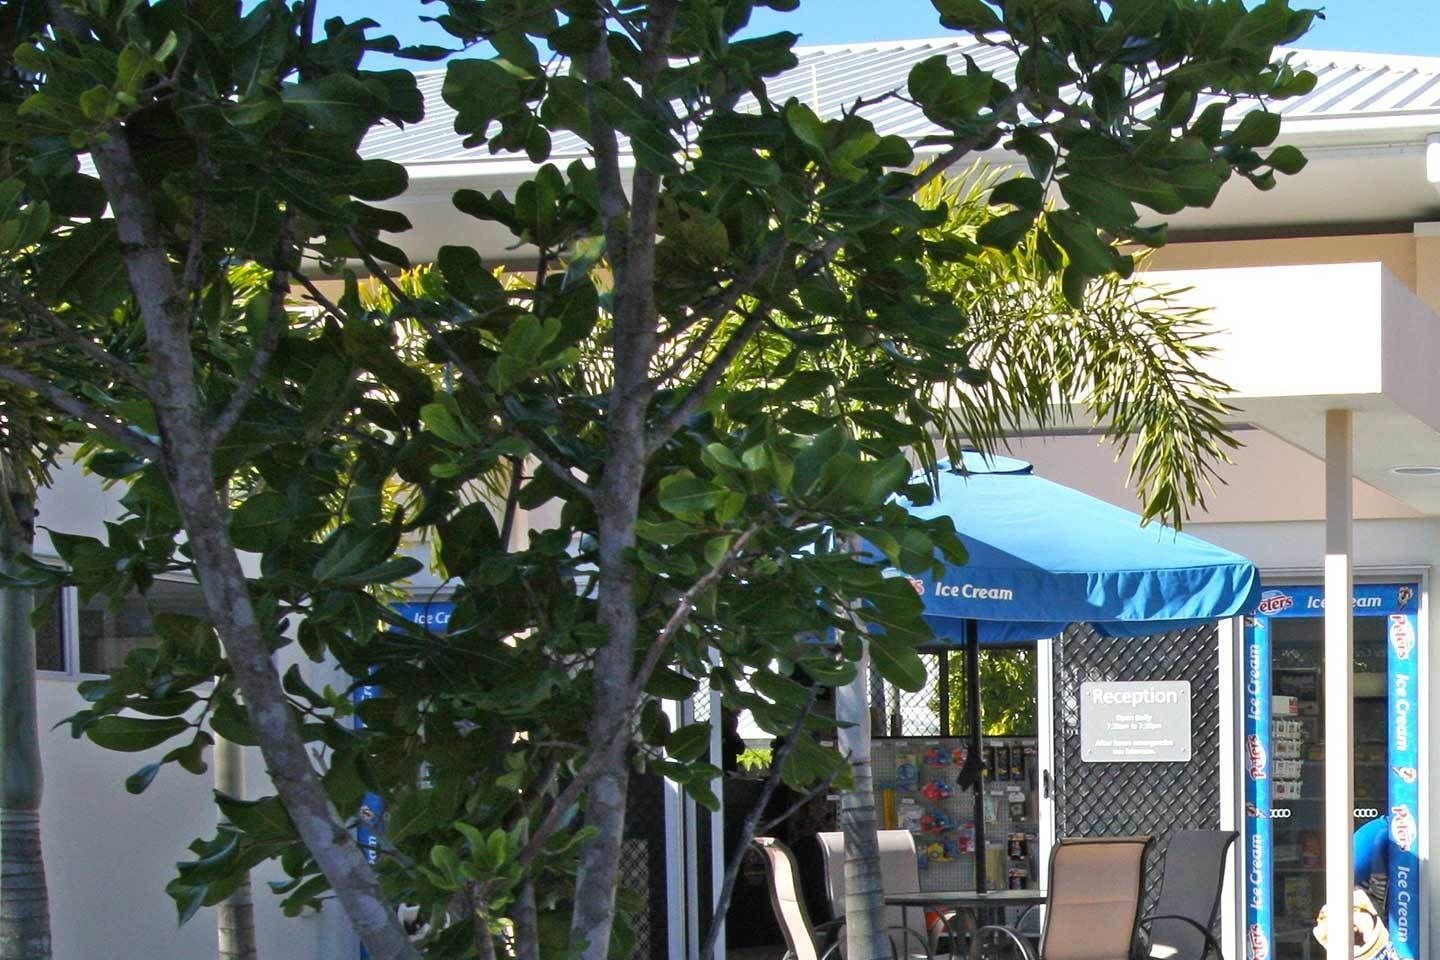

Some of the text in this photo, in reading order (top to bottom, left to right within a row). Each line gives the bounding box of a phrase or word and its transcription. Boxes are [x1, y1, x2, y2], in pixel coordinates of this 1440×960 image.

[935, 582, 959, 597] Ice
[961, 584, 1012, 600] Cream
[1259, 596, 1293, 612] eters
[1352, 597, 1381, 608] eam
[414, 613, 433, 624] Ice
[1391, 615, 1410, 752] Peters Ice Cream
[1091, 688, 1178, 707] Reception
[1248, 644, 1265, 779] Peters Ice Cream
[1392, 807, 1409, 852] Peters
[1250, 834, 1262, 883] Cream
[1398, 866, 1410, 888] Ice
[1250, 886, 1262, 910] Ice
[1398, 890, 1411, 943] Cream
